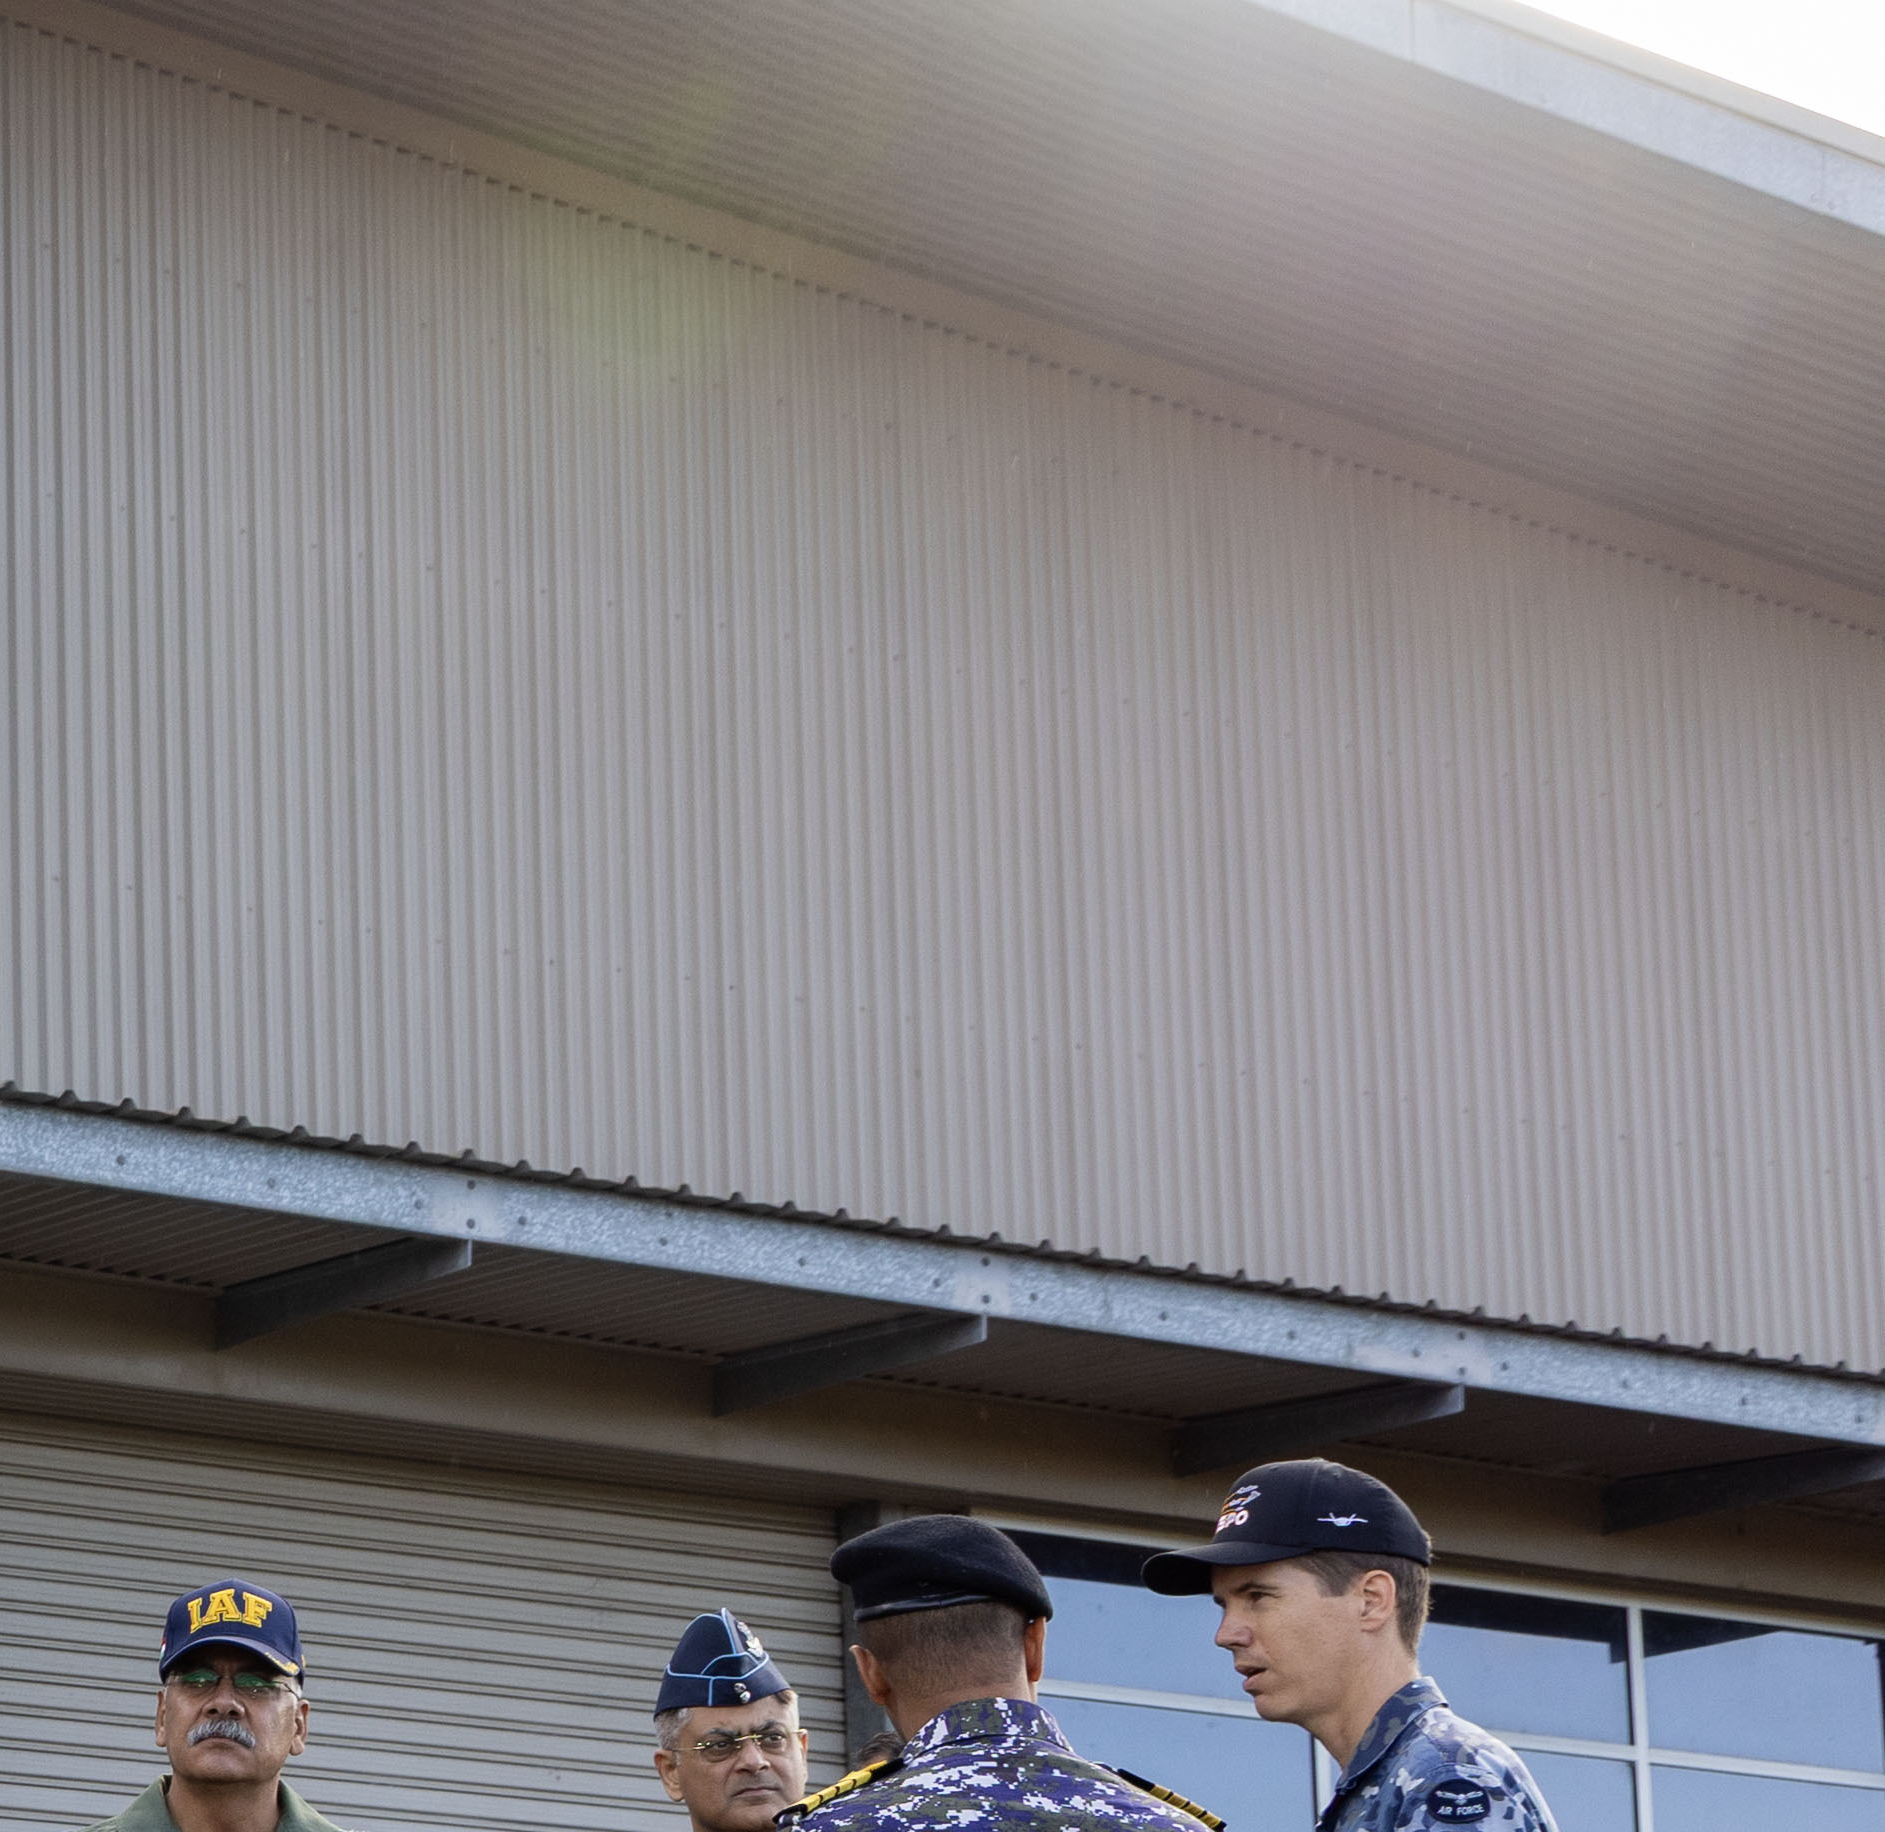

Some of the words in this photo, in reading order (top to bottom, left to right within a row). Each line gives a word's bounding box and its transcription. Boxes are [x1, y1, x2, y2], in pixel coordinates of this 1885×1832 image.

[187, 1588, 273, 1634] IAF
[1437, 1805, 1453, 1816] AIR
[1456, 1803, 1485, 1816] FORCE
